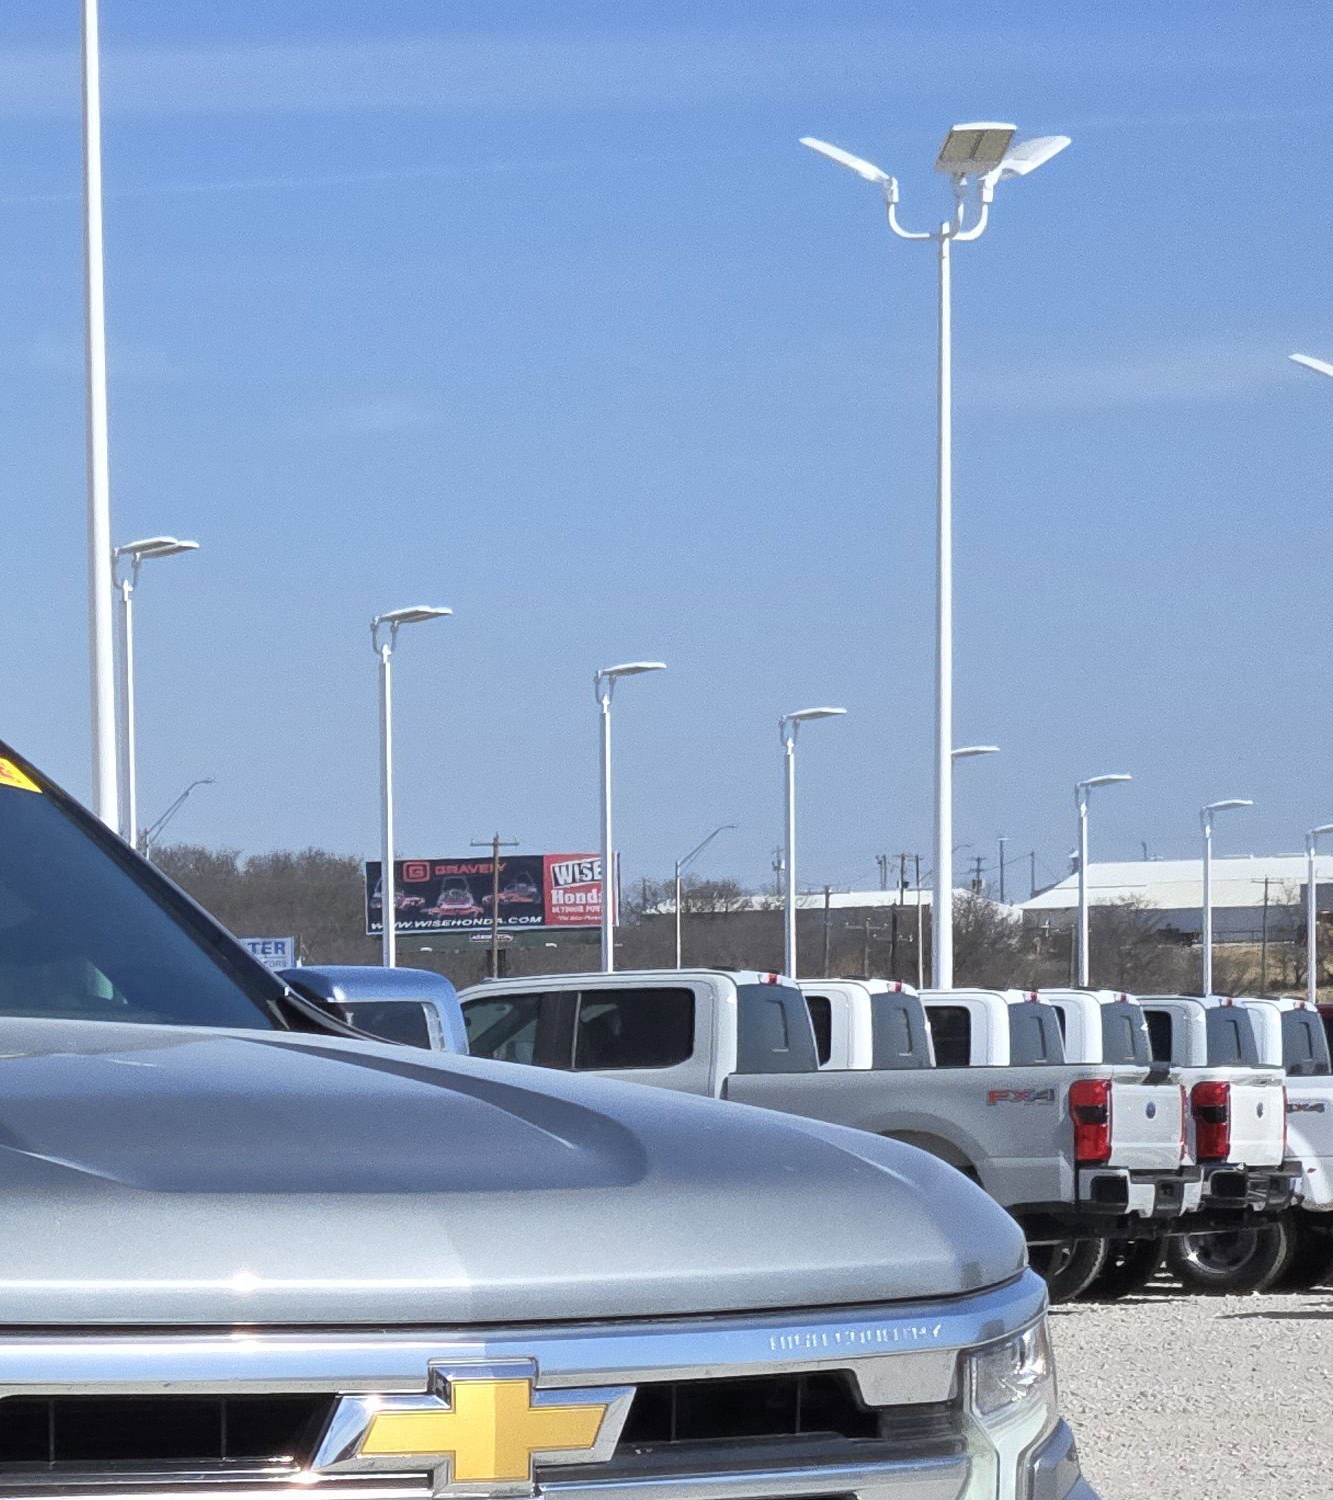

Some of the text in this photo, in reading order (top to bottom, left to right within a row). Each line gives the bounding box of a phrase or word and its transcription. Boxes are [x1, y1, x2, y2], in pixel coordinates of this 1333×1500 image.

[554, 861, 602, 885] WISE
[551, 888, 602, 904] Hond
[371, 916, 542, 930] WW.WISEHONDA.COM
[247, 941, 287, 955] TER
